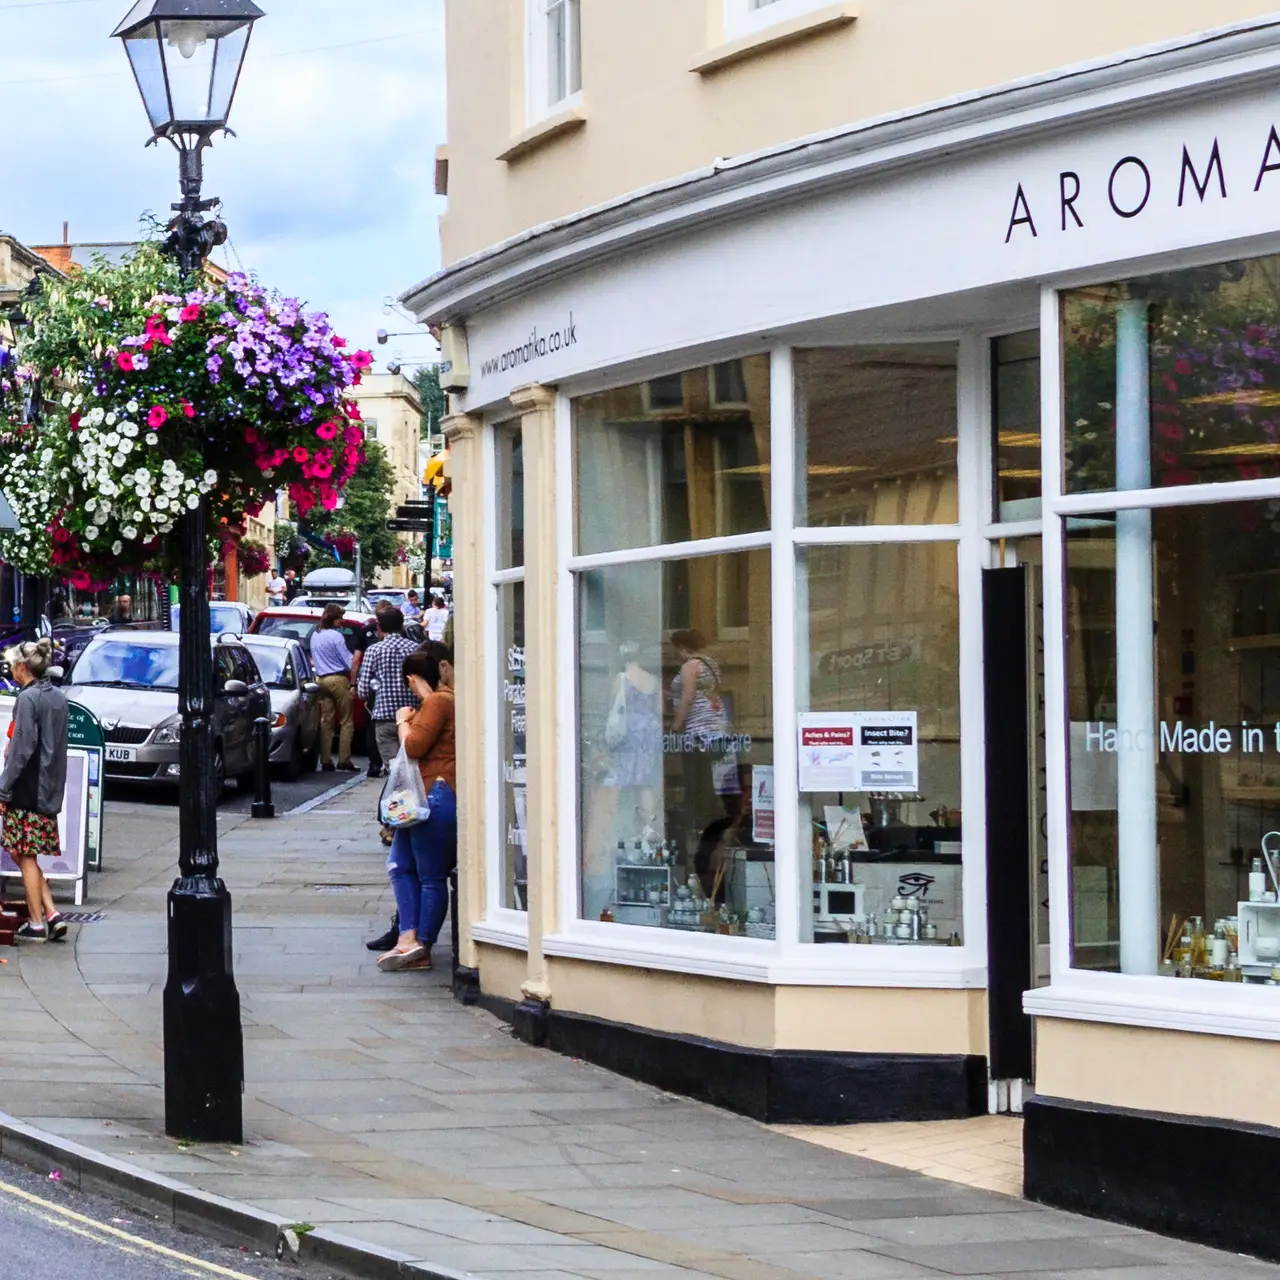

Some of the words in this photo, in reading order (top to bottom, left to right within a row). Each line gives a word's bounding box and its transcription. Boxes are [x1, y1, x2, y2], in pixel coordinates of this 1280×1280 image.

[1005, 124, 1280, 245] AROMA
[480, 312, 578, 379] www.aromatika.co.uk
[662, 733, 694, 753] atural
[1160, 721, 1232, 753] Made
[1242, 721, 1263, 752] in
[109, 749, 130, 760] KUB
